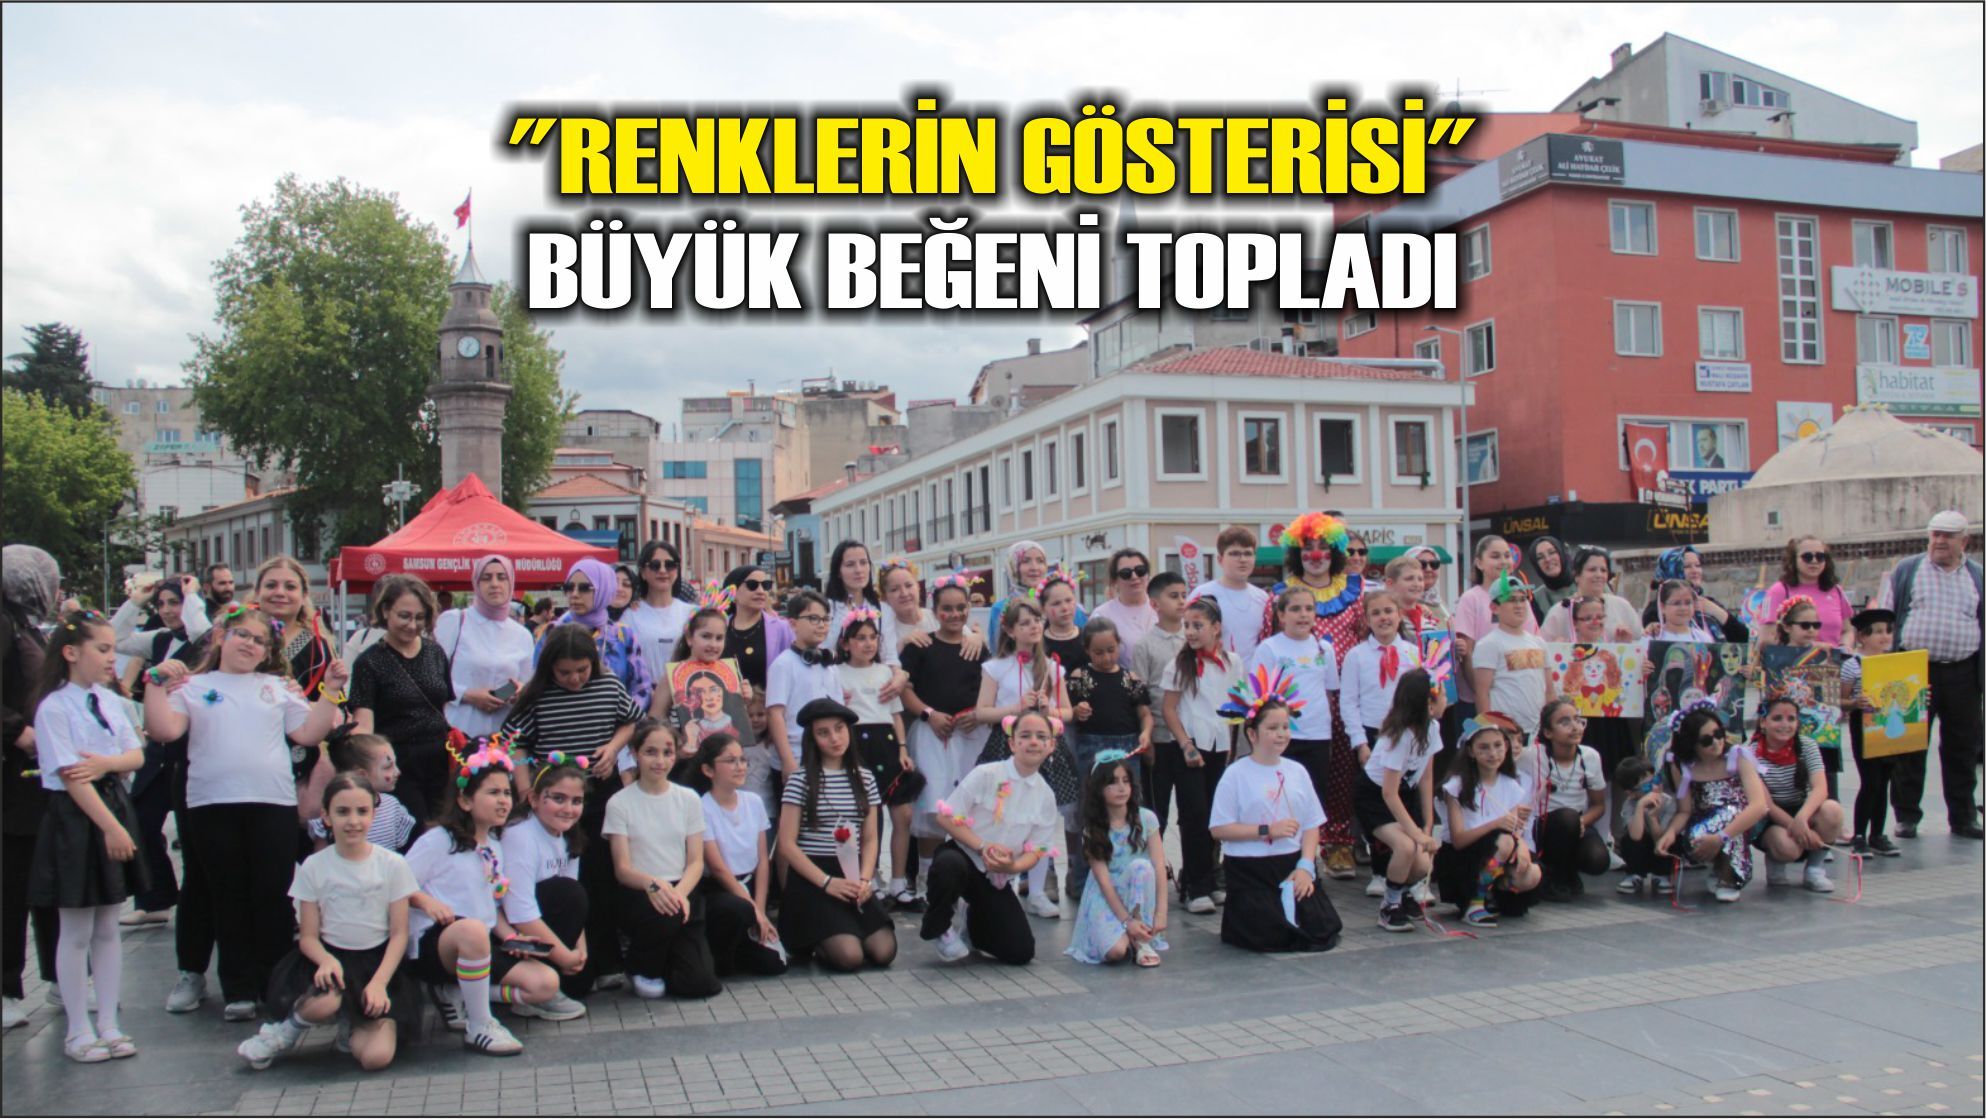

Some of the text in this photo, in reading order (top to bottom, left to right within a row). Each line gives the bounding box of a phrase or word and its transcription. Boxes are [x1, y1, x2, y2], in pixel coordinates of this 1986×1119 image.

[1879, 370, 1936, 392] habitat
[1503, 516, 1550, 535] ÜNSAL
[402, 557, 435, 570] SAMSUN
[436, 556, 471, 573] GENÇLİK
